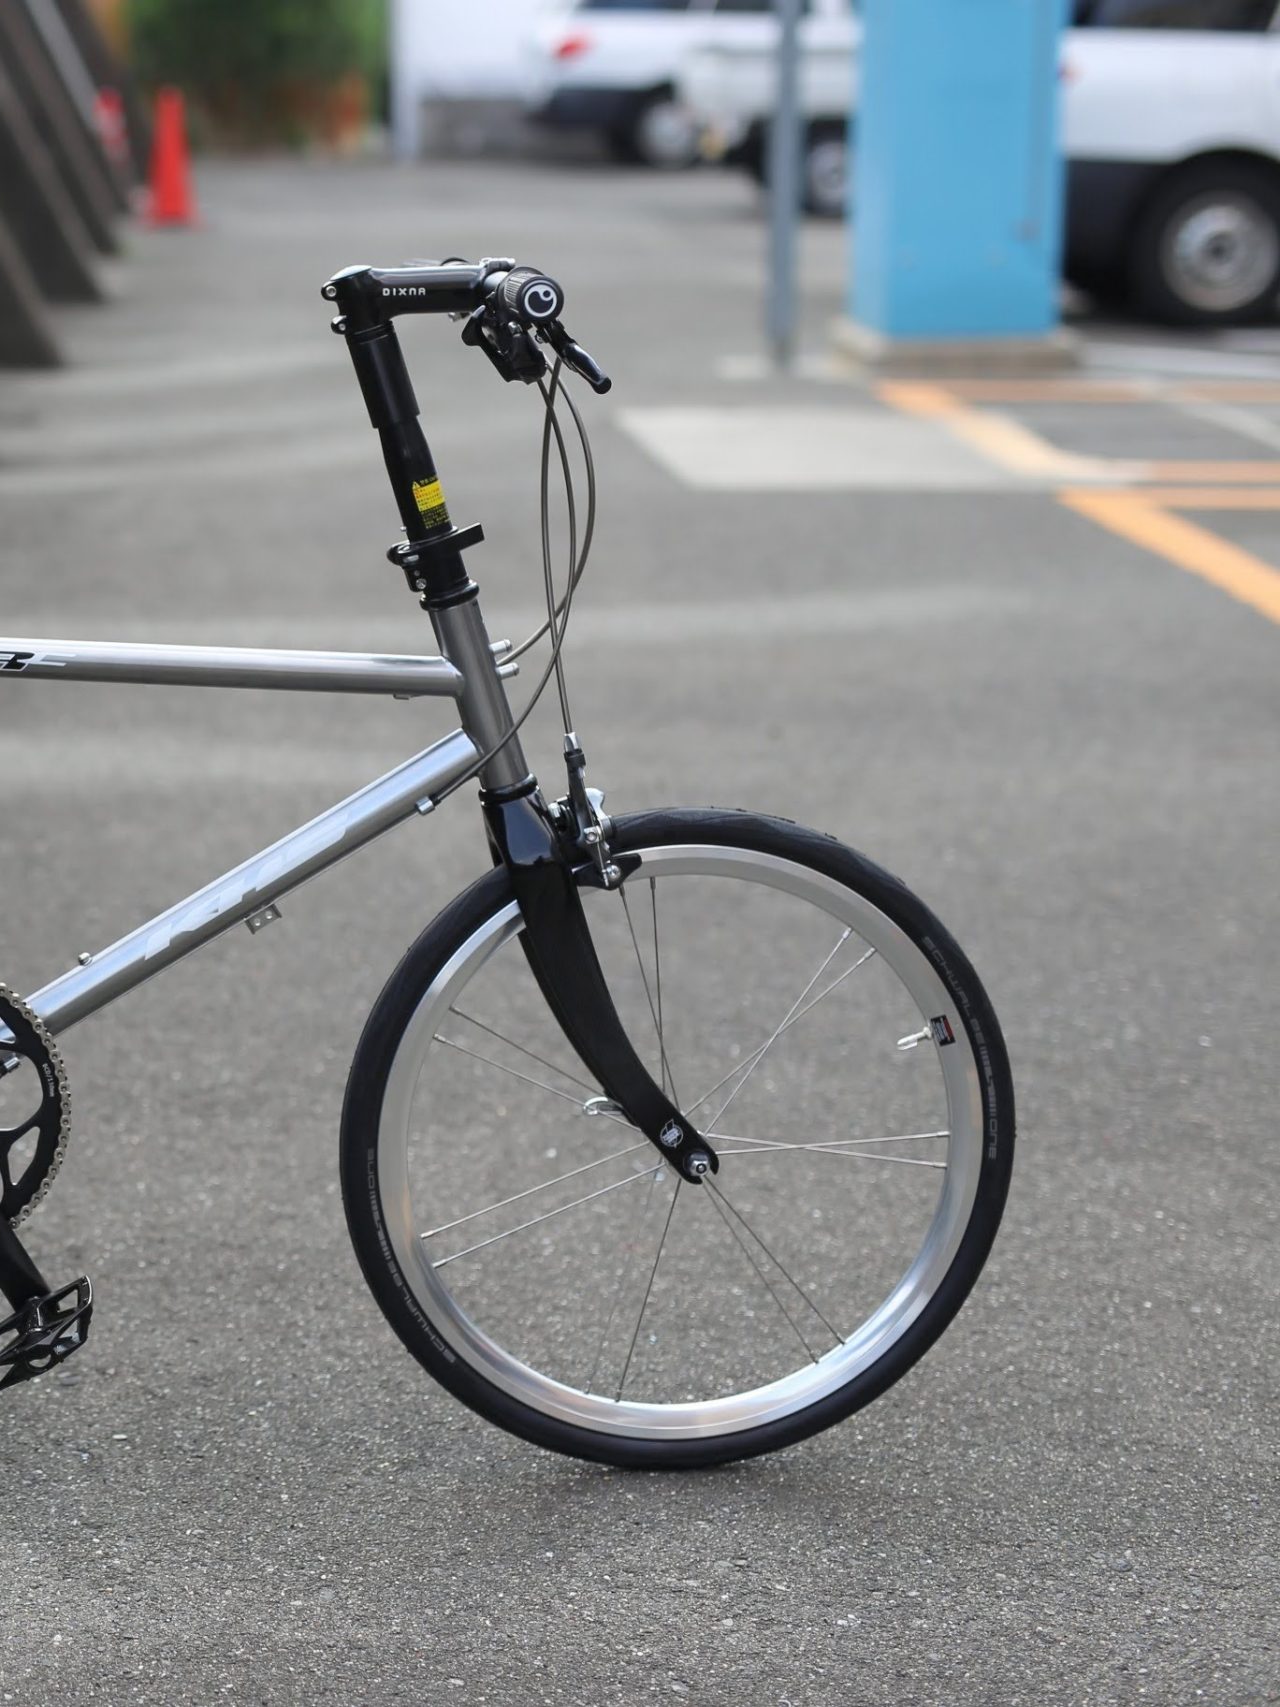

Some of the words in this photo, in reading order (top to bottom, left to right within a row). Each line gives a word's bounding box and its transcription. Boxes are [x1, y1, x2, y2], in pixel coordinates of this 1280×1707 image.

[382, 287, 426, 296] DIXNA
[924, 938, 985, 1041] SCHWALBE
[988, 1119, 998, 1160] ONE
[386, 1260, 456, 1363] SCHWALBE
